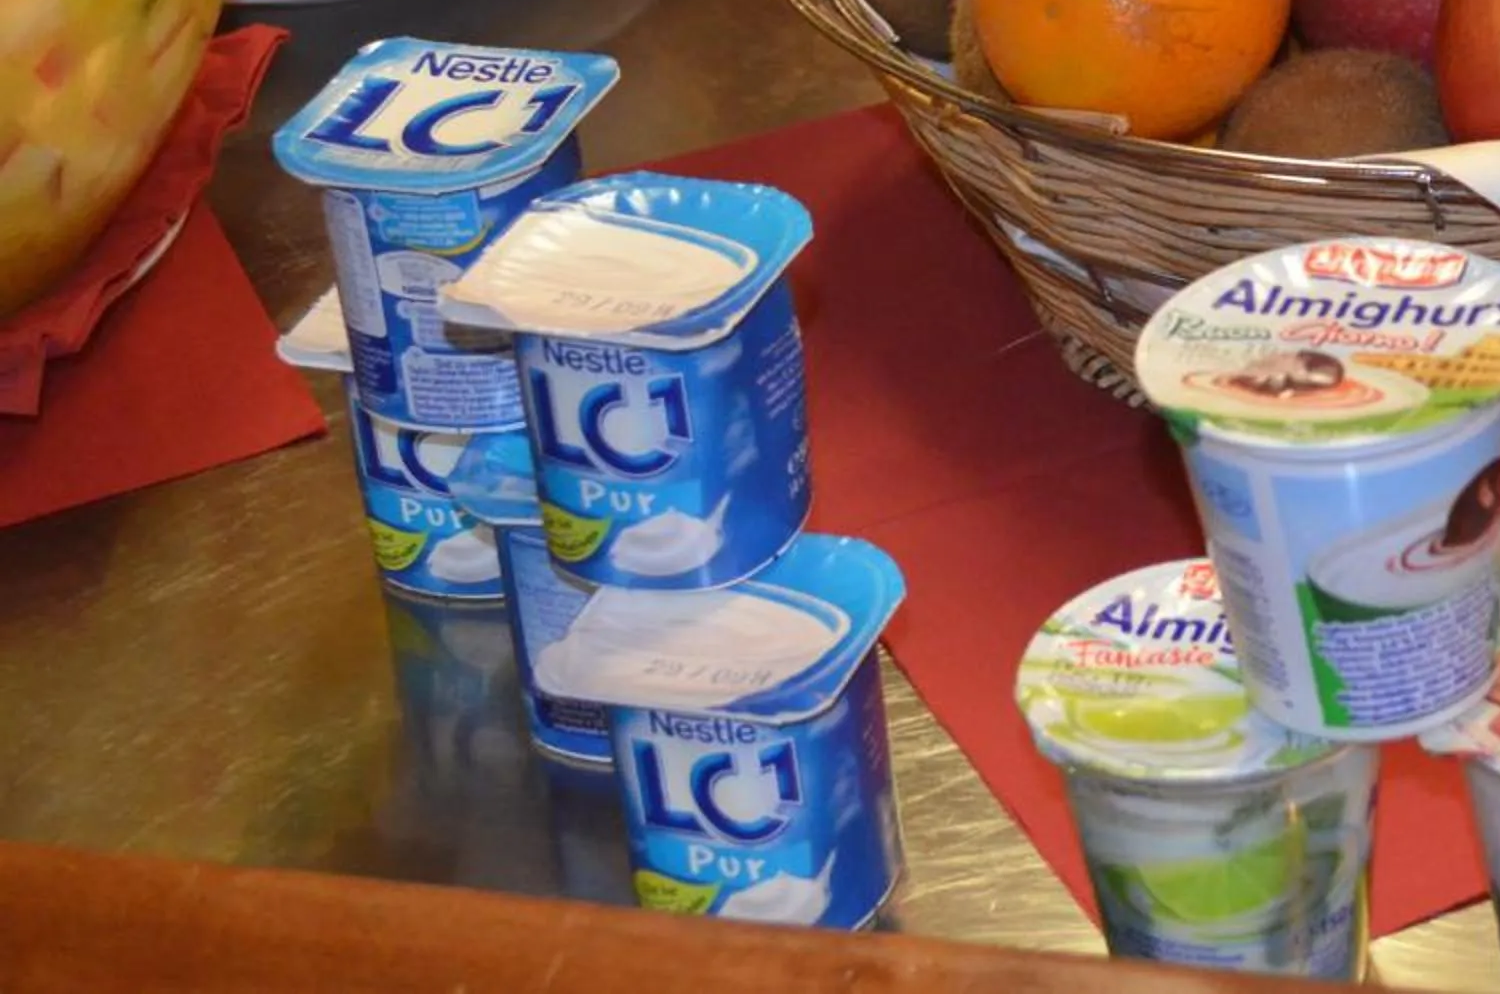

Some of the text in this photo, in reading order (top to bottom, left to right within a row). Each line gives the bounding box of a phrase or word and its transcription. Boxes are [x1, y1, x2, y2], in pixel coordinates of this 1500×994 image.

[530, 368, 691, 477] LC1
[579, 479, 656, 514] Pur
[632, 738, 800, 842] LC1
[687, 844, 766, 880] Pur
